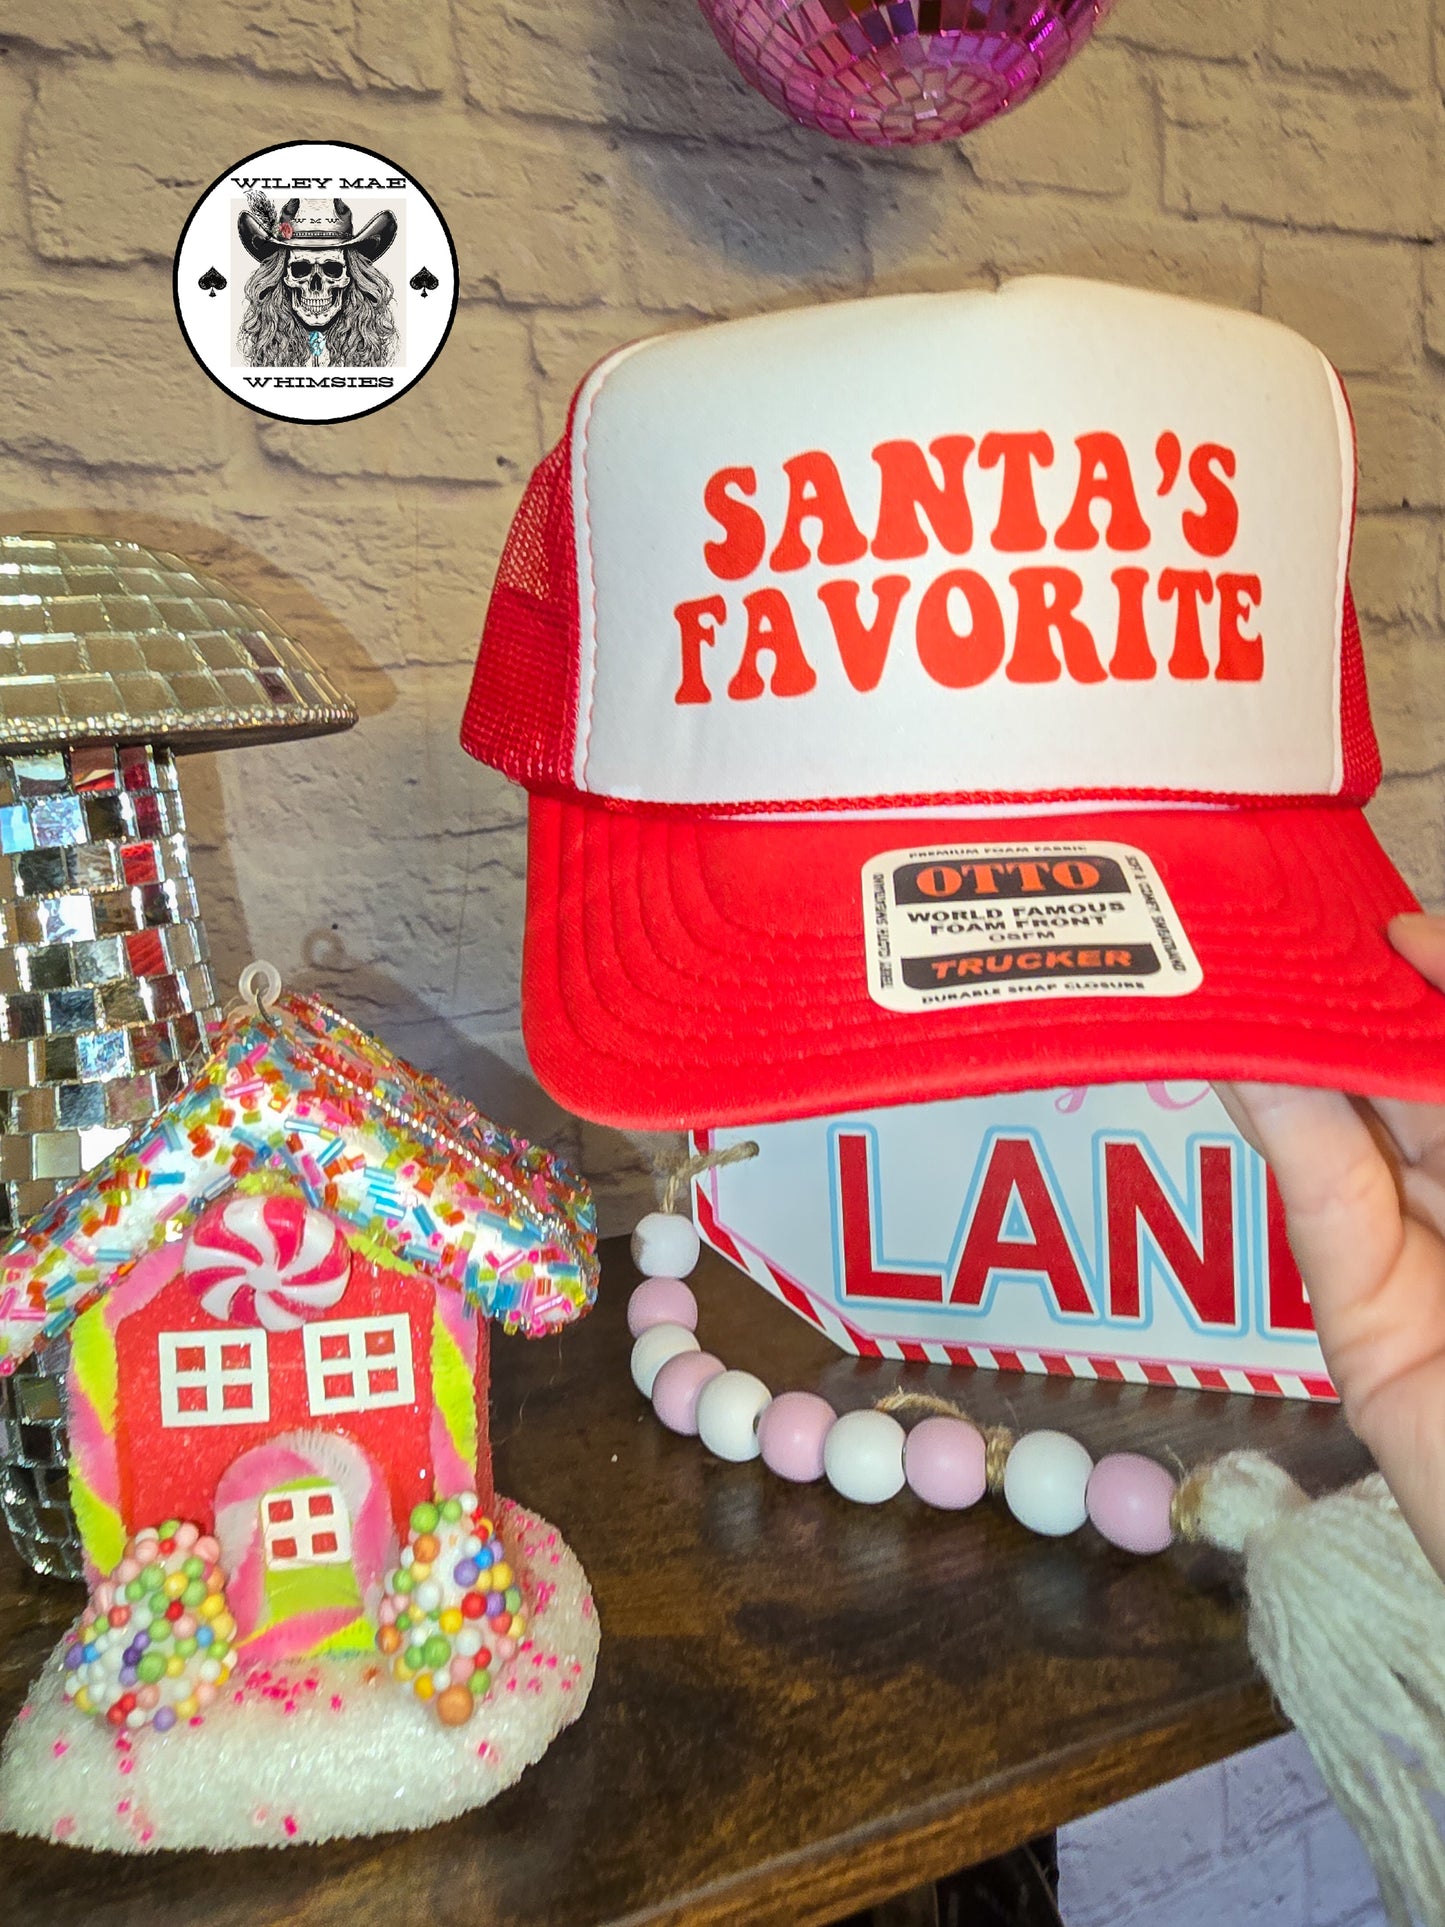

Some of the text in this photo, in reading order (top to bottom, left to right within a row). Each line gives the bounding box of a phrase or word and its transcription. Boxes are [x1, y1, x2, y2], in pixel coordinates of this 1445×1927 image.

[703, 430, 1239, 581] SANTA'S
[674, 566, 1264, 705] FAVORITE
[909, 844, 1088, 859] PREMIUM FOAM FABRIC
[916, 860, 1100, 897] OTTO
[908, 901, 1126, 923] WORLD FAMOUS
[930, 914, 1108, 935] FOAM FRONT
[988, 931, 1055, 943] OSFM
[931, 950, 1133, 980] TRUCKER
[922, 980, 1146, 1005] DURABLE SNAP CLOSURE
